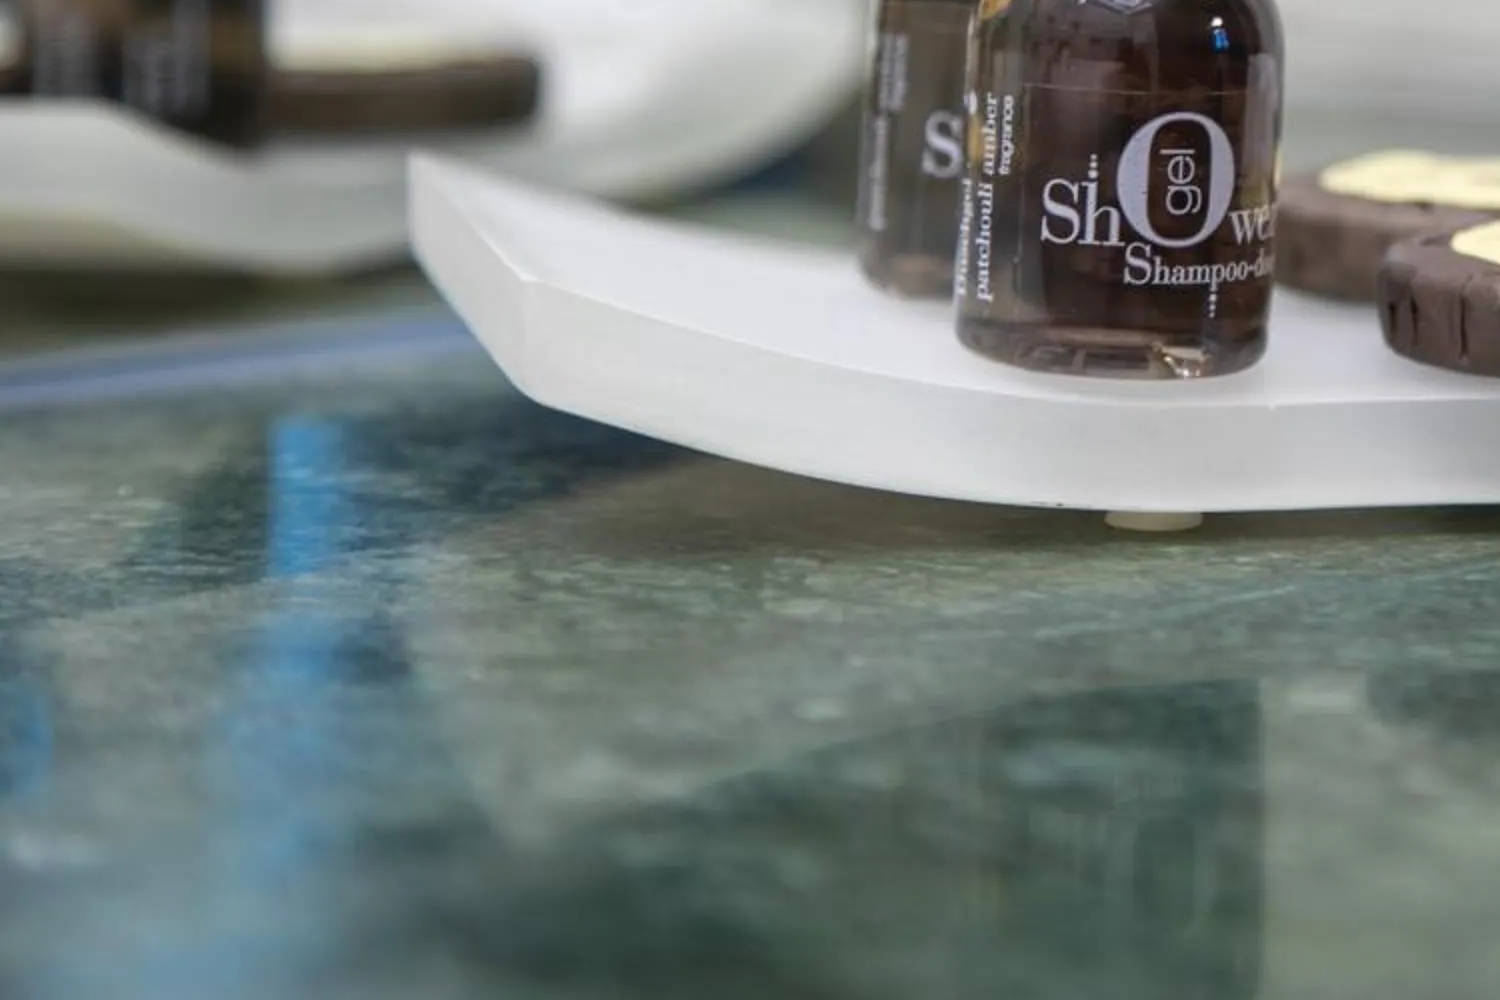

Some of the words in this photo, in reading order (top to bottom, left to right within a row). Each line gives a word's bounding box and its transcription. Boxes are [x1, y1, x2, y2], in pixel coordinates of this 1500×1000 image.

[982, 91, 997, 177] amber
[1159, 148, 1201, 216] gel
[975, 182, 995, 303] patchouli
